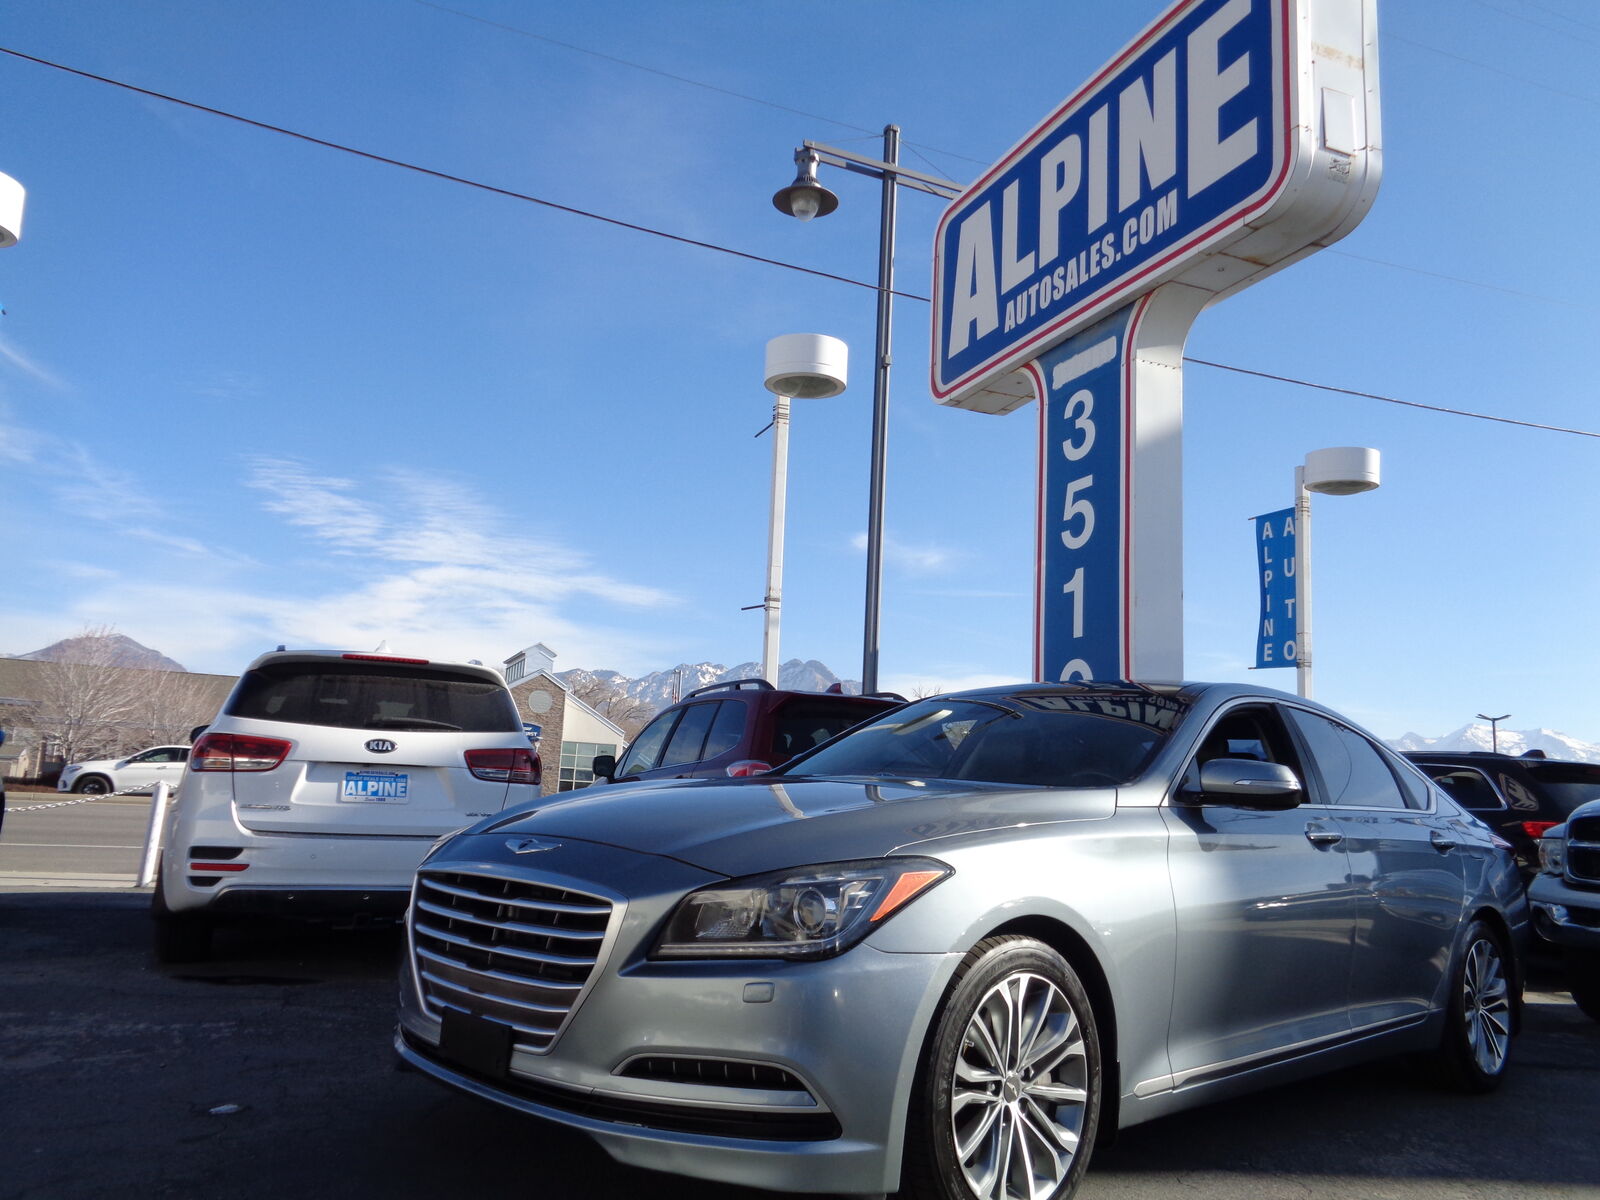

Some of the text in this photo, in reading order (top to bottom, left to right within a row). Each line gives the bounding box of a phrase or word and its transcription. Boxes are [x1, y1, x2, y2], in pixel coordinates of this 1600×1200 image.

[948, 0, 1258, 359] ALPINE
[1004, 189, 1178, 334] AUTOSALES.COM
[1262, 521, 1273, 662] ALPINE
[1283, 517, 1296, 661] AUTO
[345, 781, 407, 797] ALPINE
[369, 741, 392, 750] KIA
